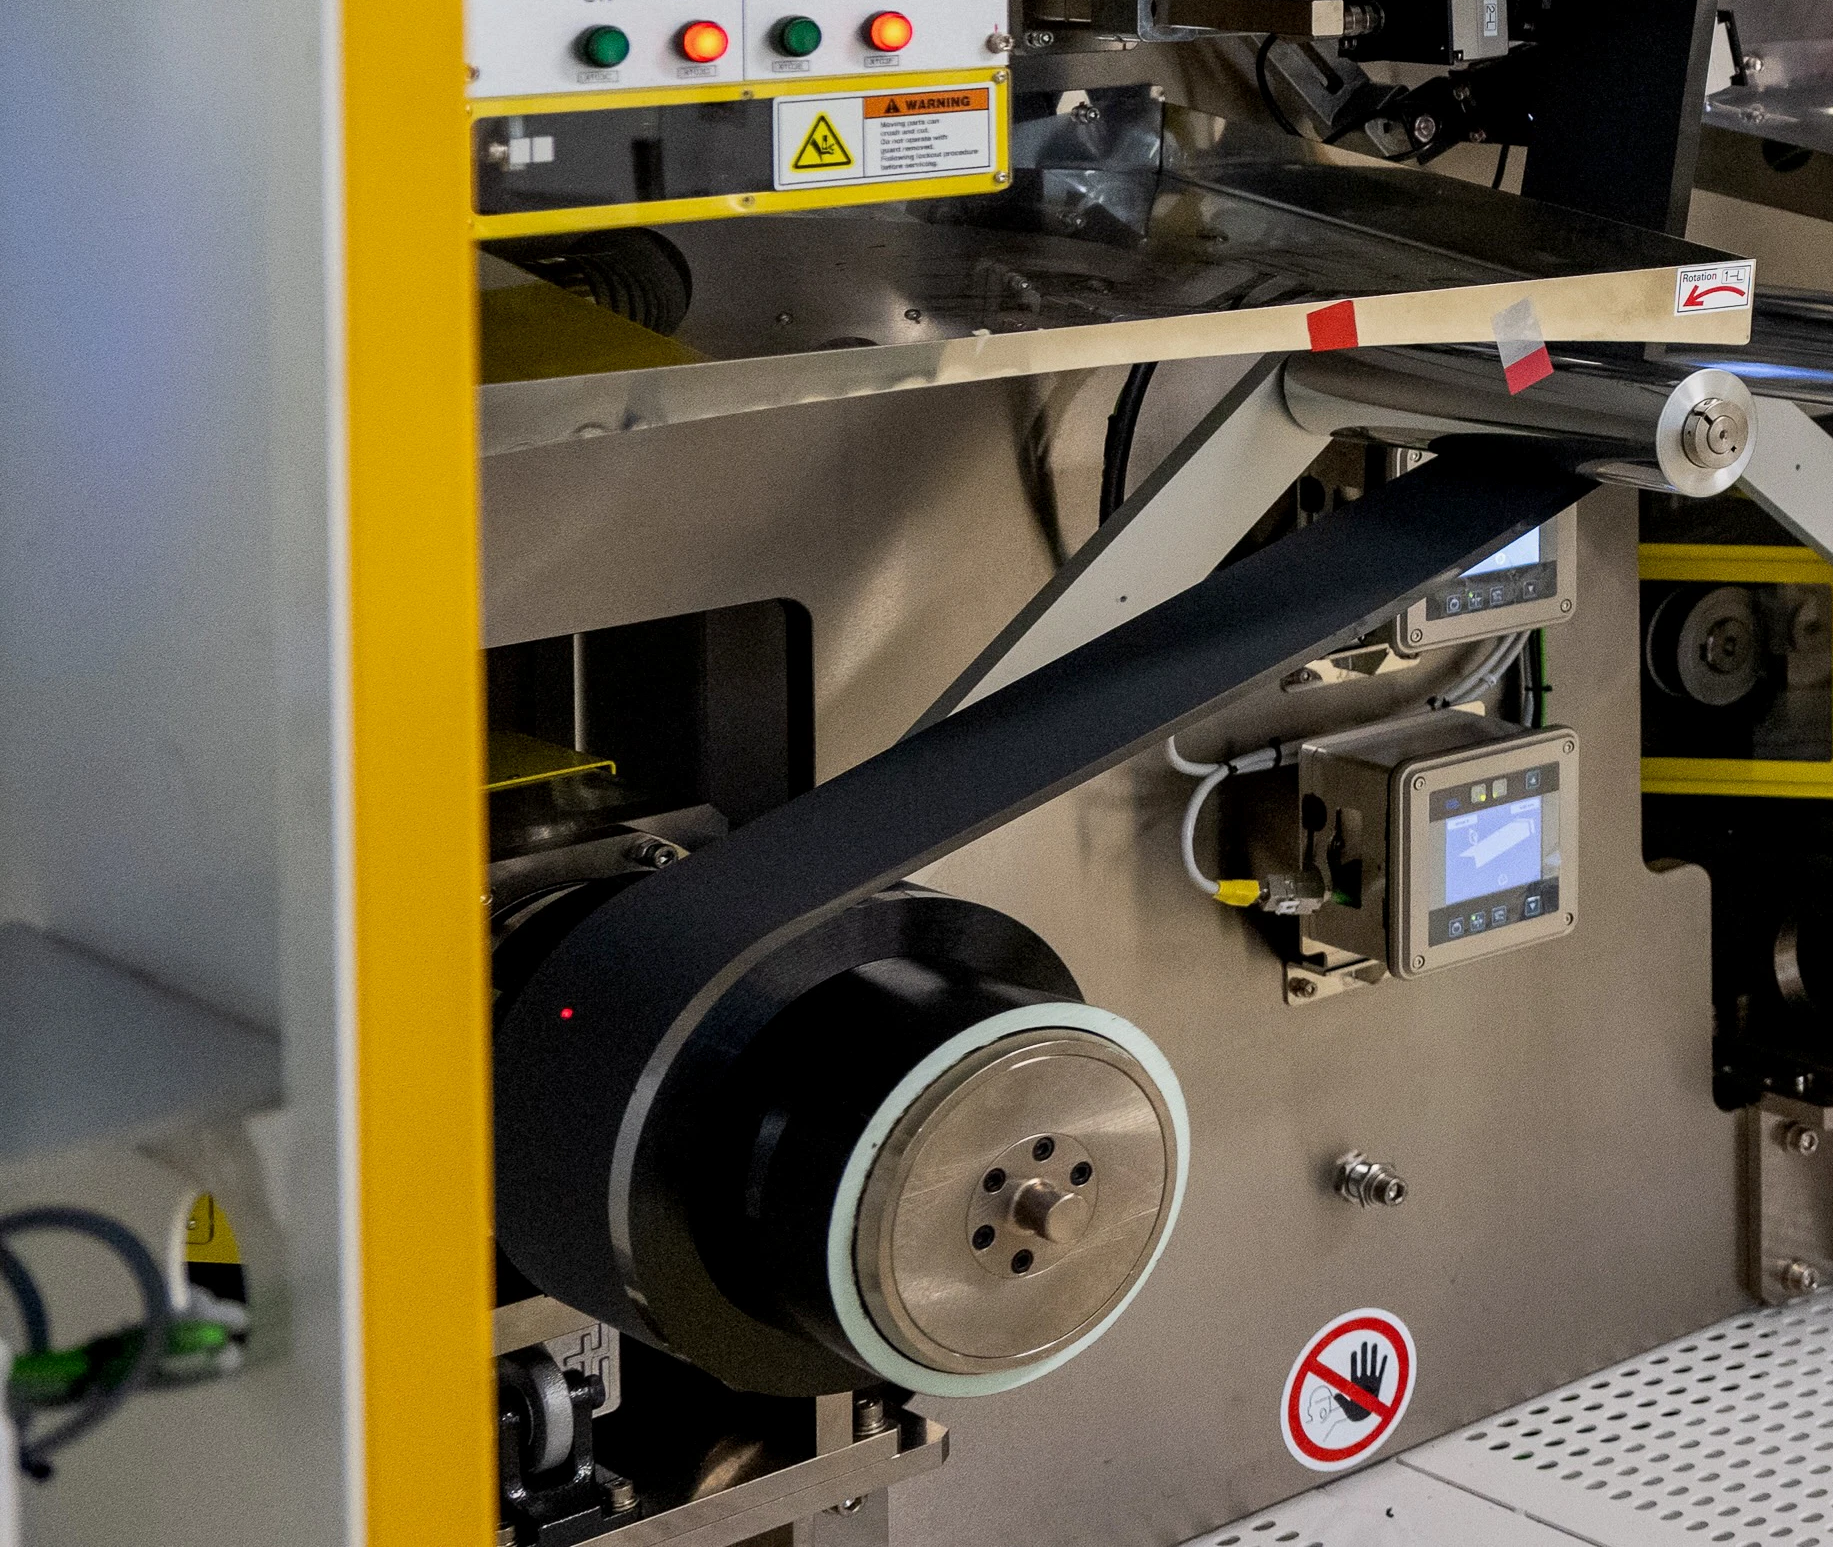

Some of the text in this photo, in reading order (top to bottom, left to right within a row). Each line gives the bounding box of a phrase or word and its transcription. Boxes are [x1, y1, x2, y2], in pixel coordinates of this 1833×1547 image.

[905, 96, 970, 110] WARNING
[880, 120, 906, 129] Moving
[907, 118, 926, 127] parts
[902, 127, 915, 135] and
[905, 136, 932, 144] operate
[880, 147, 901, 155] guard
[943, 148, 979, 158] procedure
[880, 162, 903, 171] before
[1682, 272, 1717, 283] Rotation
